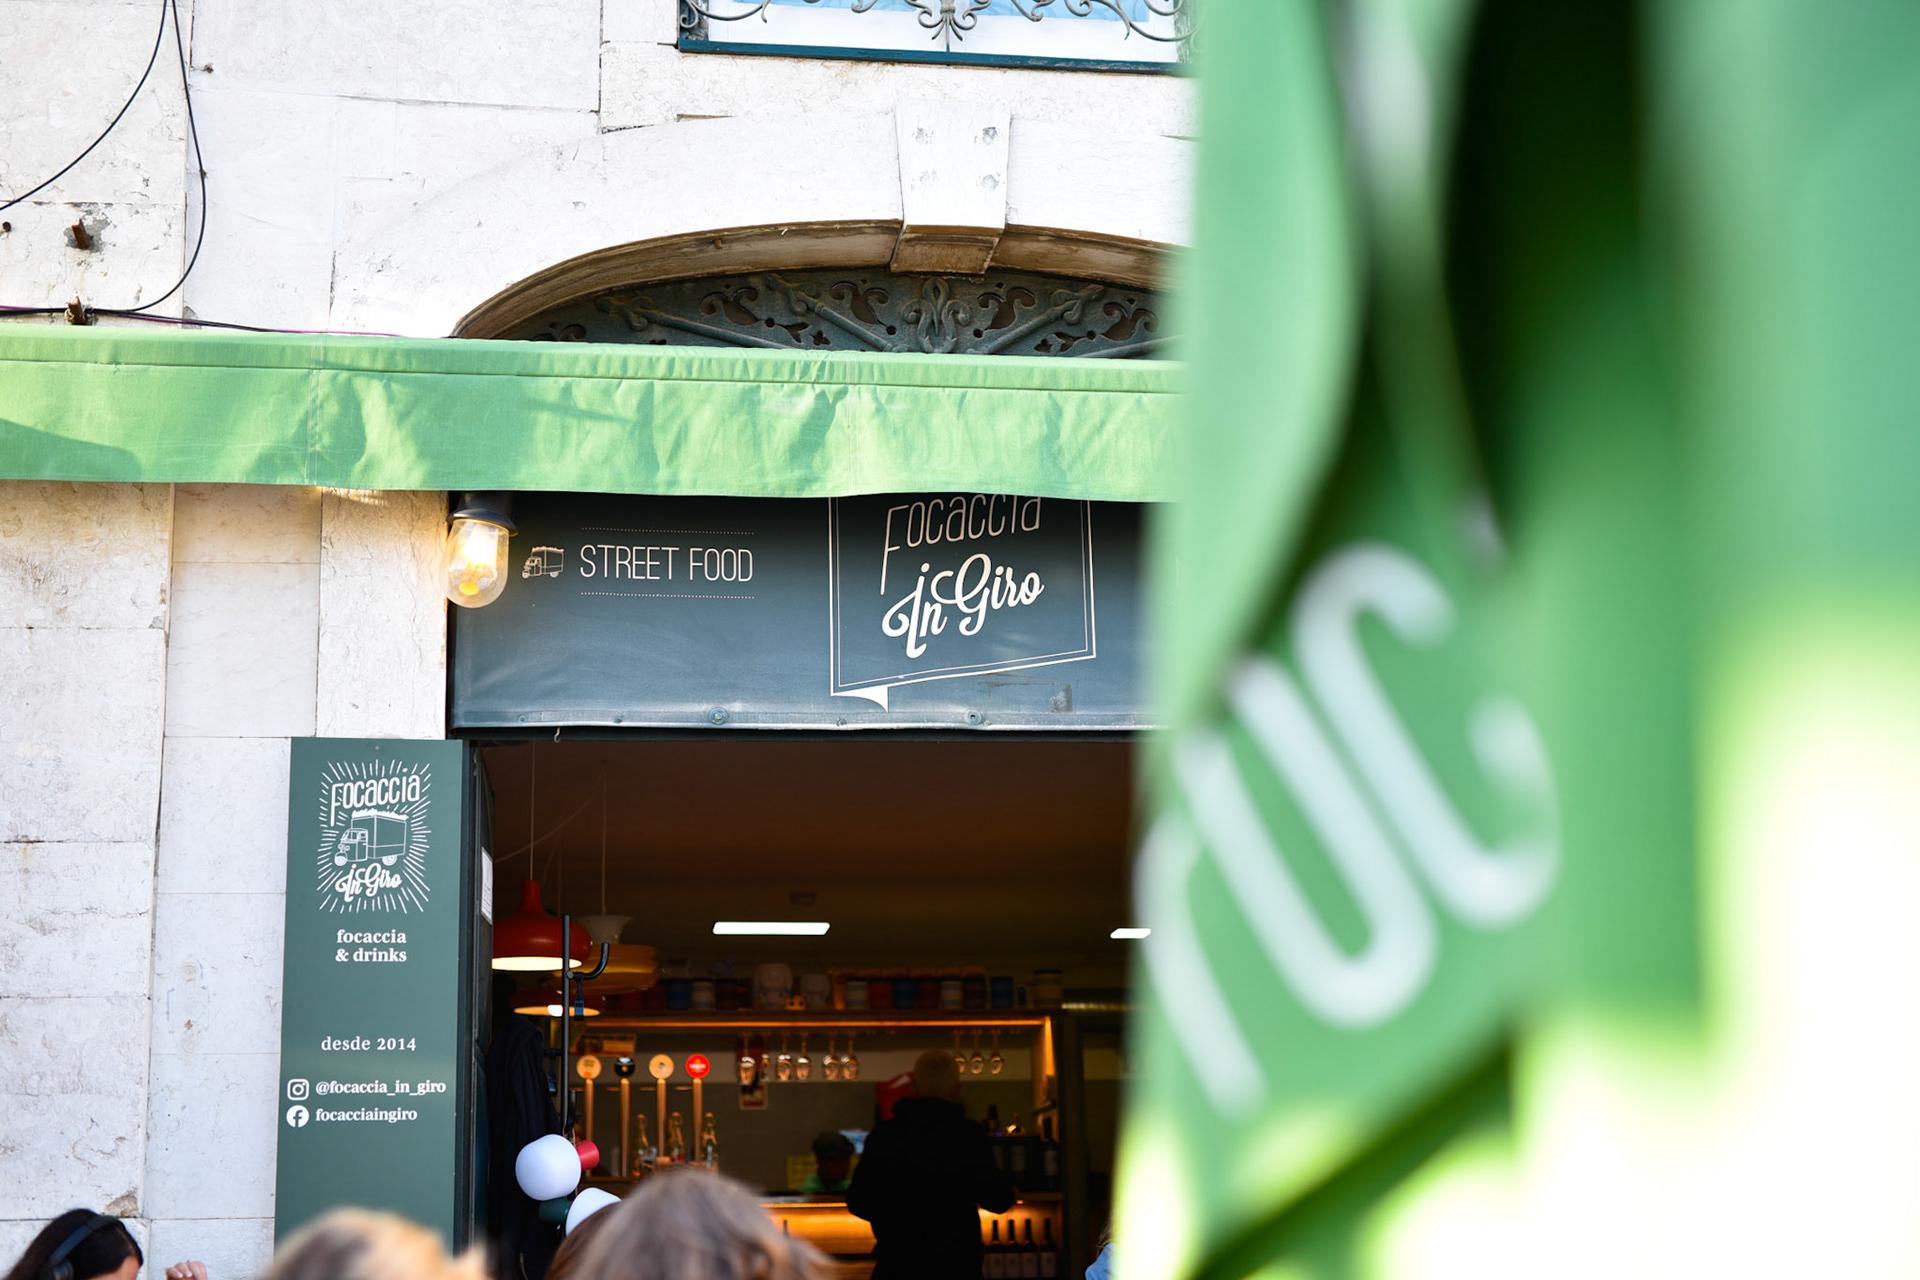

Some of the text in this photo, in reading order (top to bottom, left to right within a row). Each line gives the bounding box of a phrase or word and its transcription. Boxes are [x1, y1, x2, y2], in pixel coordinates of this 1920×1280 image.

[580, 545, 754, 582] STREET FOOD
[931, 553, 1045, 636] Giro
[330, 768, 421, 827] Focaccia
[355, 862, 402, 897] Giro
[336, 929, 407, 943] focaccia
[335, 947, 407, 962] & drinks
[321, 1036, 417, 1051] desde 2014
[315, 1080, 447, 1096] @focaccia_in_giro
[315, 1107, 418, 1123] focacciaingiro
